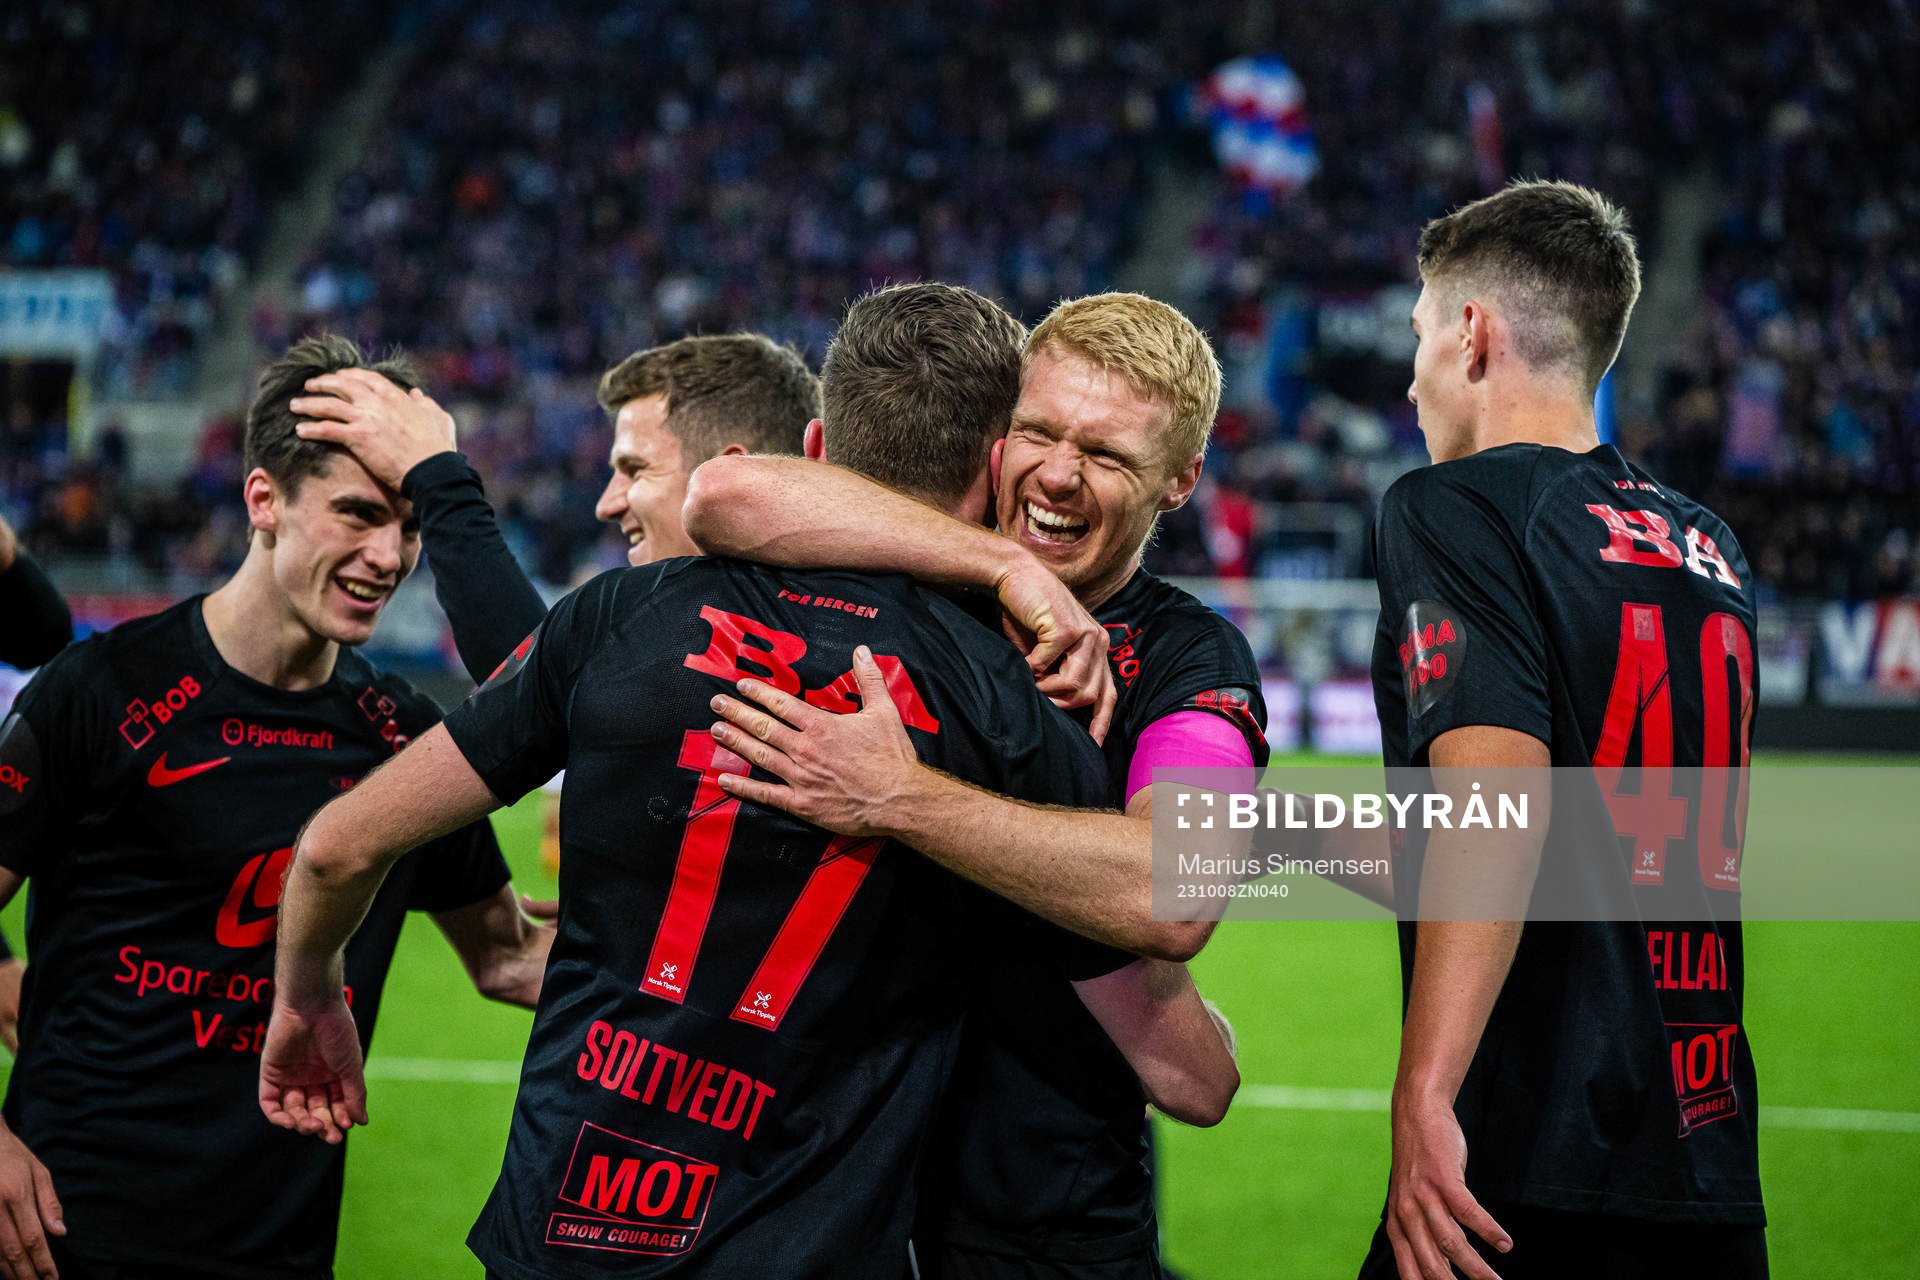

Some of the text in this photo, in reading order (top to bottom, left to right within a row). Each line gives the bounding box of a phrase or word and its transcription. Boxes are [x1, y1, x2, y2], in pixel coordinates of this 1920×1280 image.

[1584, 503, 1742, 590] BA
[777, 589, 879, 619] FOR BERGEN
[683, 605, 939, 734] BA
[151, 675, 201, 724] BOB
[247, 724, 334, 750] Fjordkraft
[1592, 601, 1753, 892] 40
[647, 977, 682, 994] Norsk Tipping
[741, 1005, 777, 1022] Norsk Tipping
[577, 1020, 776, 1141] SOLTVEDT
[580, 1154, 720, 1220] MOT
[556, 1222, 687, 1249] SHOW COURAGE!
